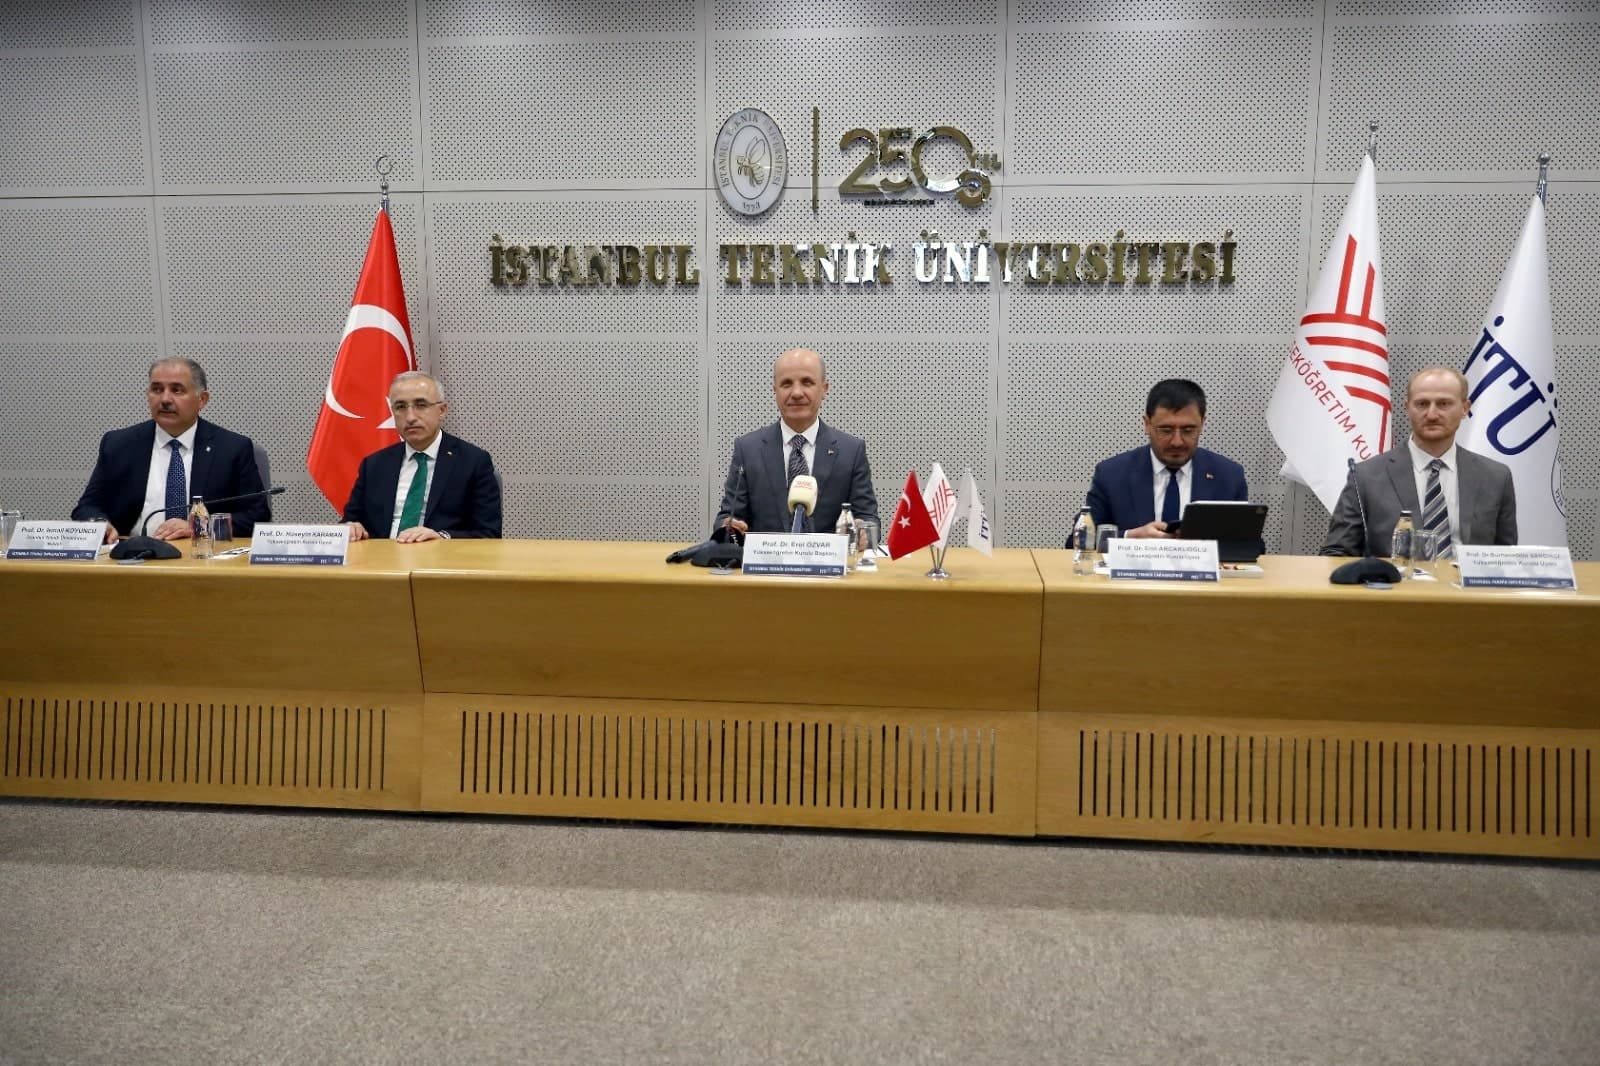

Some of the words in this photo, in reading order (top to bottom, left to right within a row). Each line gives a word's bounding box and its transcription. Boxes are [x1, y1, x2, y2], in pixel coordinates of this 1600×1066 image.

[839, 126, 991, 208] 250
[488, 232, 700, 287] İSTANBUL
[718, 230, 894, 286] TEKNİK
[911, 228, 1238, 286] ÜNİVERSİTESİ
[1289, 340, 1357, 433] EKÖĞRETİM
[1462, 315, 1558, 456] İTÜ
[762, 540, 777, 548] Prof.
